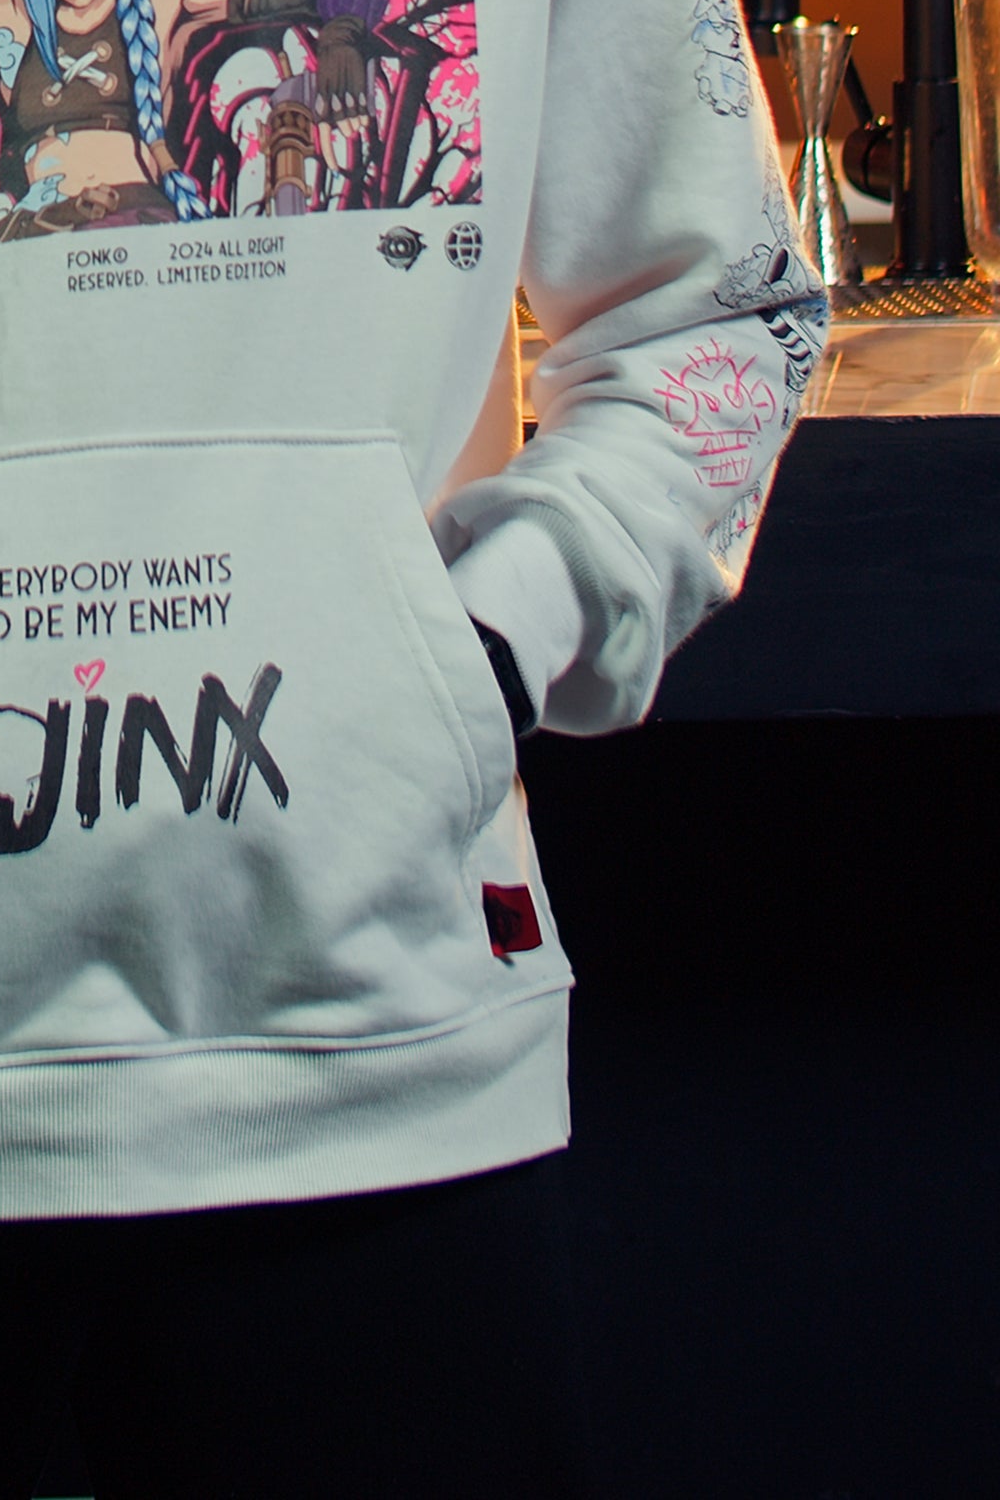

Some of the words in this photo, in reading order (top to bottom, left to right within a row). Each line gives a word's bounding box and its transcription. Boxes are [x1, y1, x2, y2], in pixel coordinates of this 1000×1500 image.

[169, 241, 213, 260] 2024
[219, 239, 243, 257] ALL
[247, 235, 285, 255] RIGHT
[157, 264, 221, 285] LIMITED
[225, 260, 286, 280] EDITION
[143, 553, 232, 588] WANTS
[25, 604, 64, 640] BE
[76, 601, 117, 637] MY
[129, 592, 232, 633] ENEMY
